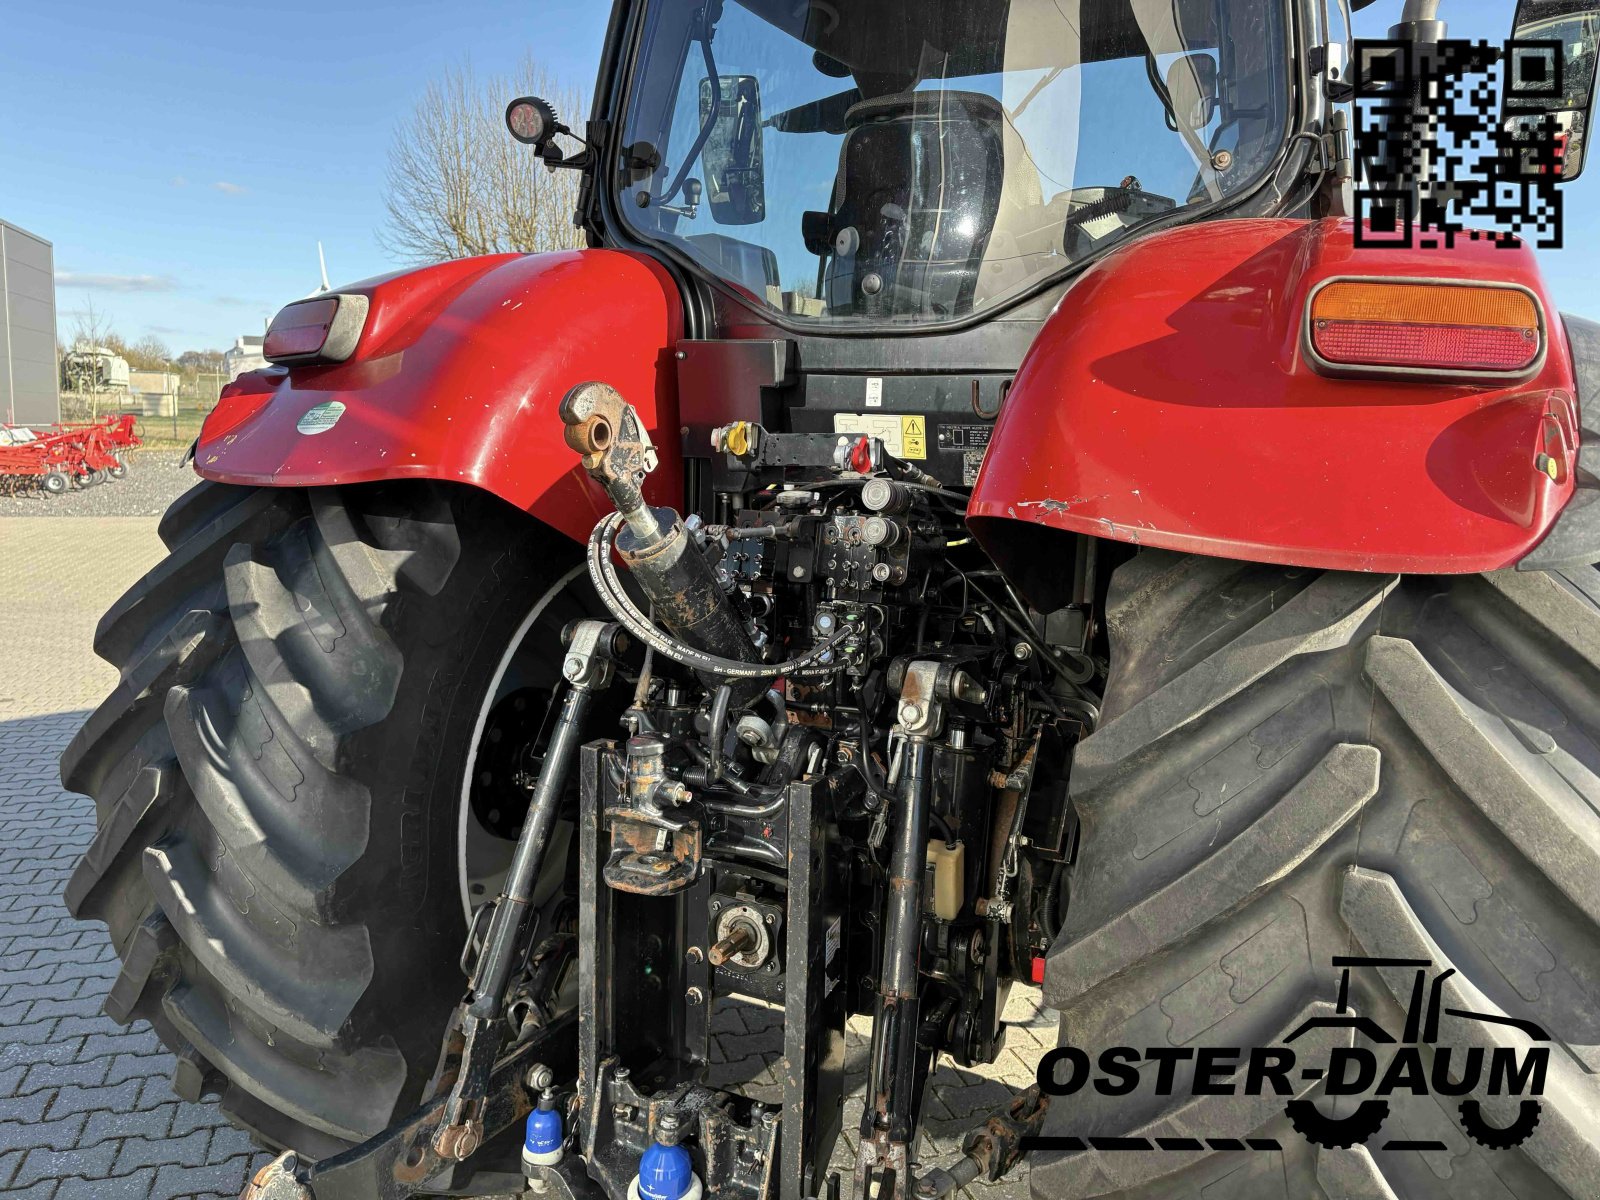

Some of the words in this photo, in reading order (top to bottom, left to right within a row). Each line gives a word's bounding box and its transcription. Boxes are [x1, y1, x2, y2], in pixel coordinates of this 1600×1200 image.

[616, 591, 625, 602] WP
[640, 619, 650, 629] WP
[659, 634, 673, 646] BAR
[616, 611, 625, 621] WP
[633, 627, 646, 640] BAR
[648, 638, 667, 653] MADE
[666, 648, 674, 657] IN
[673, 652, 684, 661] EU
[713, 665, 723, 673] SH
[726, 667, 757, 676] GERMANY
